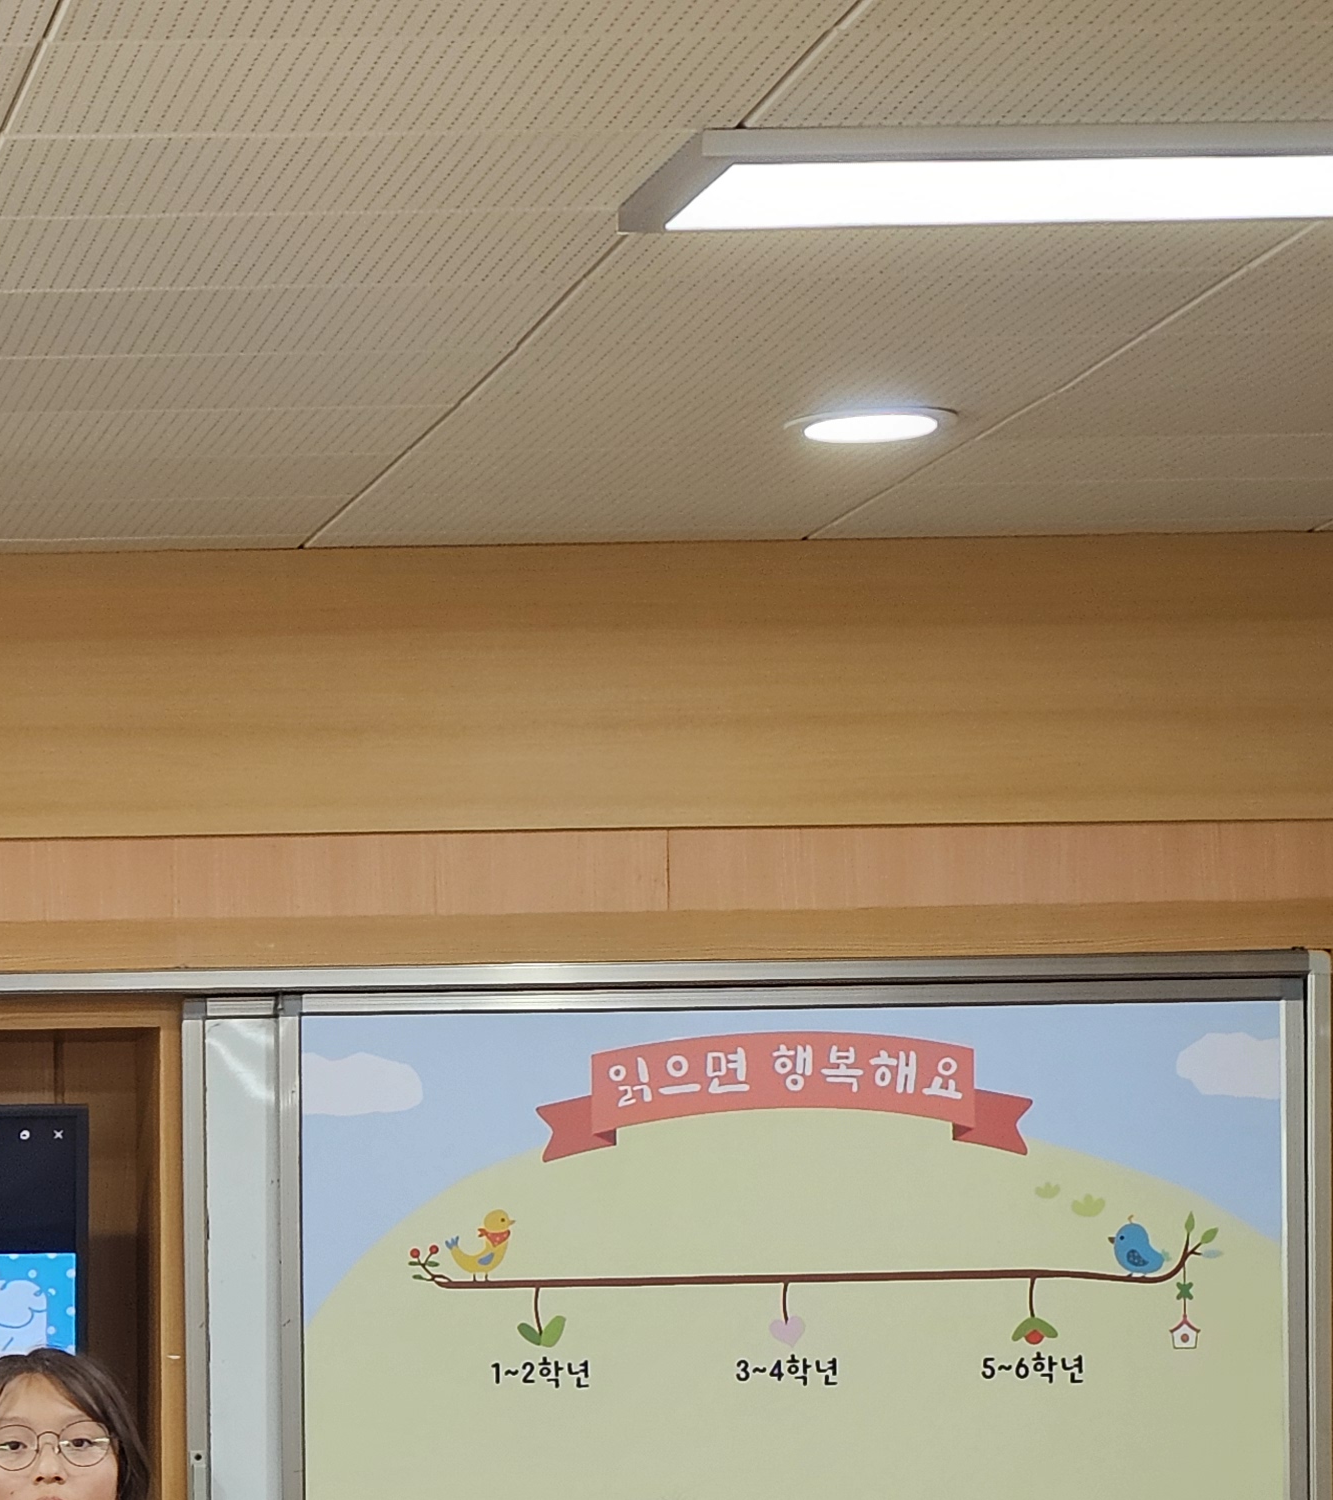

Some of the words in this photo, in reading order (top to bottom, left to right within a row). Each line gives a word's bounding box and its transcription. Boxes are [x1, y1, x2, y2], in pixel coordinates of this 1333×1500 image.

[606, 1044, 750, 1109] 읽으면
[771, 1043, 965, 1103] 행복해요
[490, 1355, 591, 1389] 1~2학년
[735, 1353, 839, 1387] 3~4학년
[980, 1351, 1085, 1385] 5~6학년
